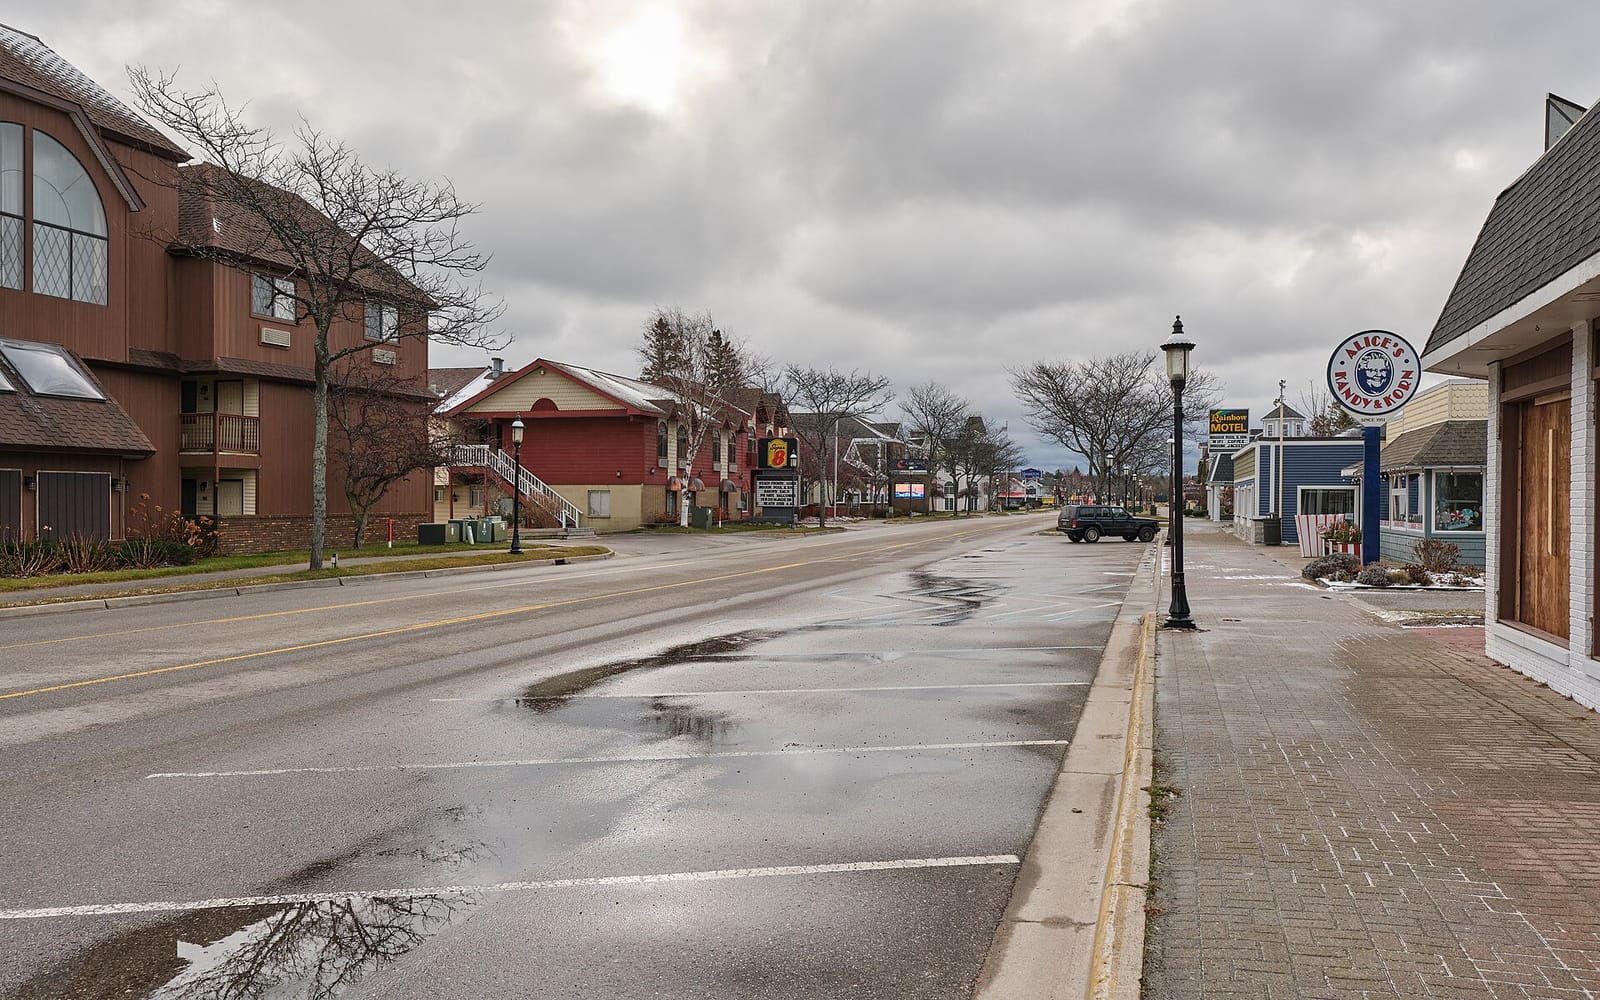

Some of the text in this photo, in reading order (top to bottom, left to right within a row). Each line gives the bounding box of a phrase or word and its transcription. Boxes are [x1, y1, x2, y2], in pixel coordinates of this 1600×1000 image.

[1346, 336, 1405, 360] ALICE'S
[1334, 370, 1414, 409] KANDY & KORN
[1211, 411, 1247, 423] Rainbow
[1211, 424, 1247, 432] MOTEL
[773, 450, 785, 466] 8
